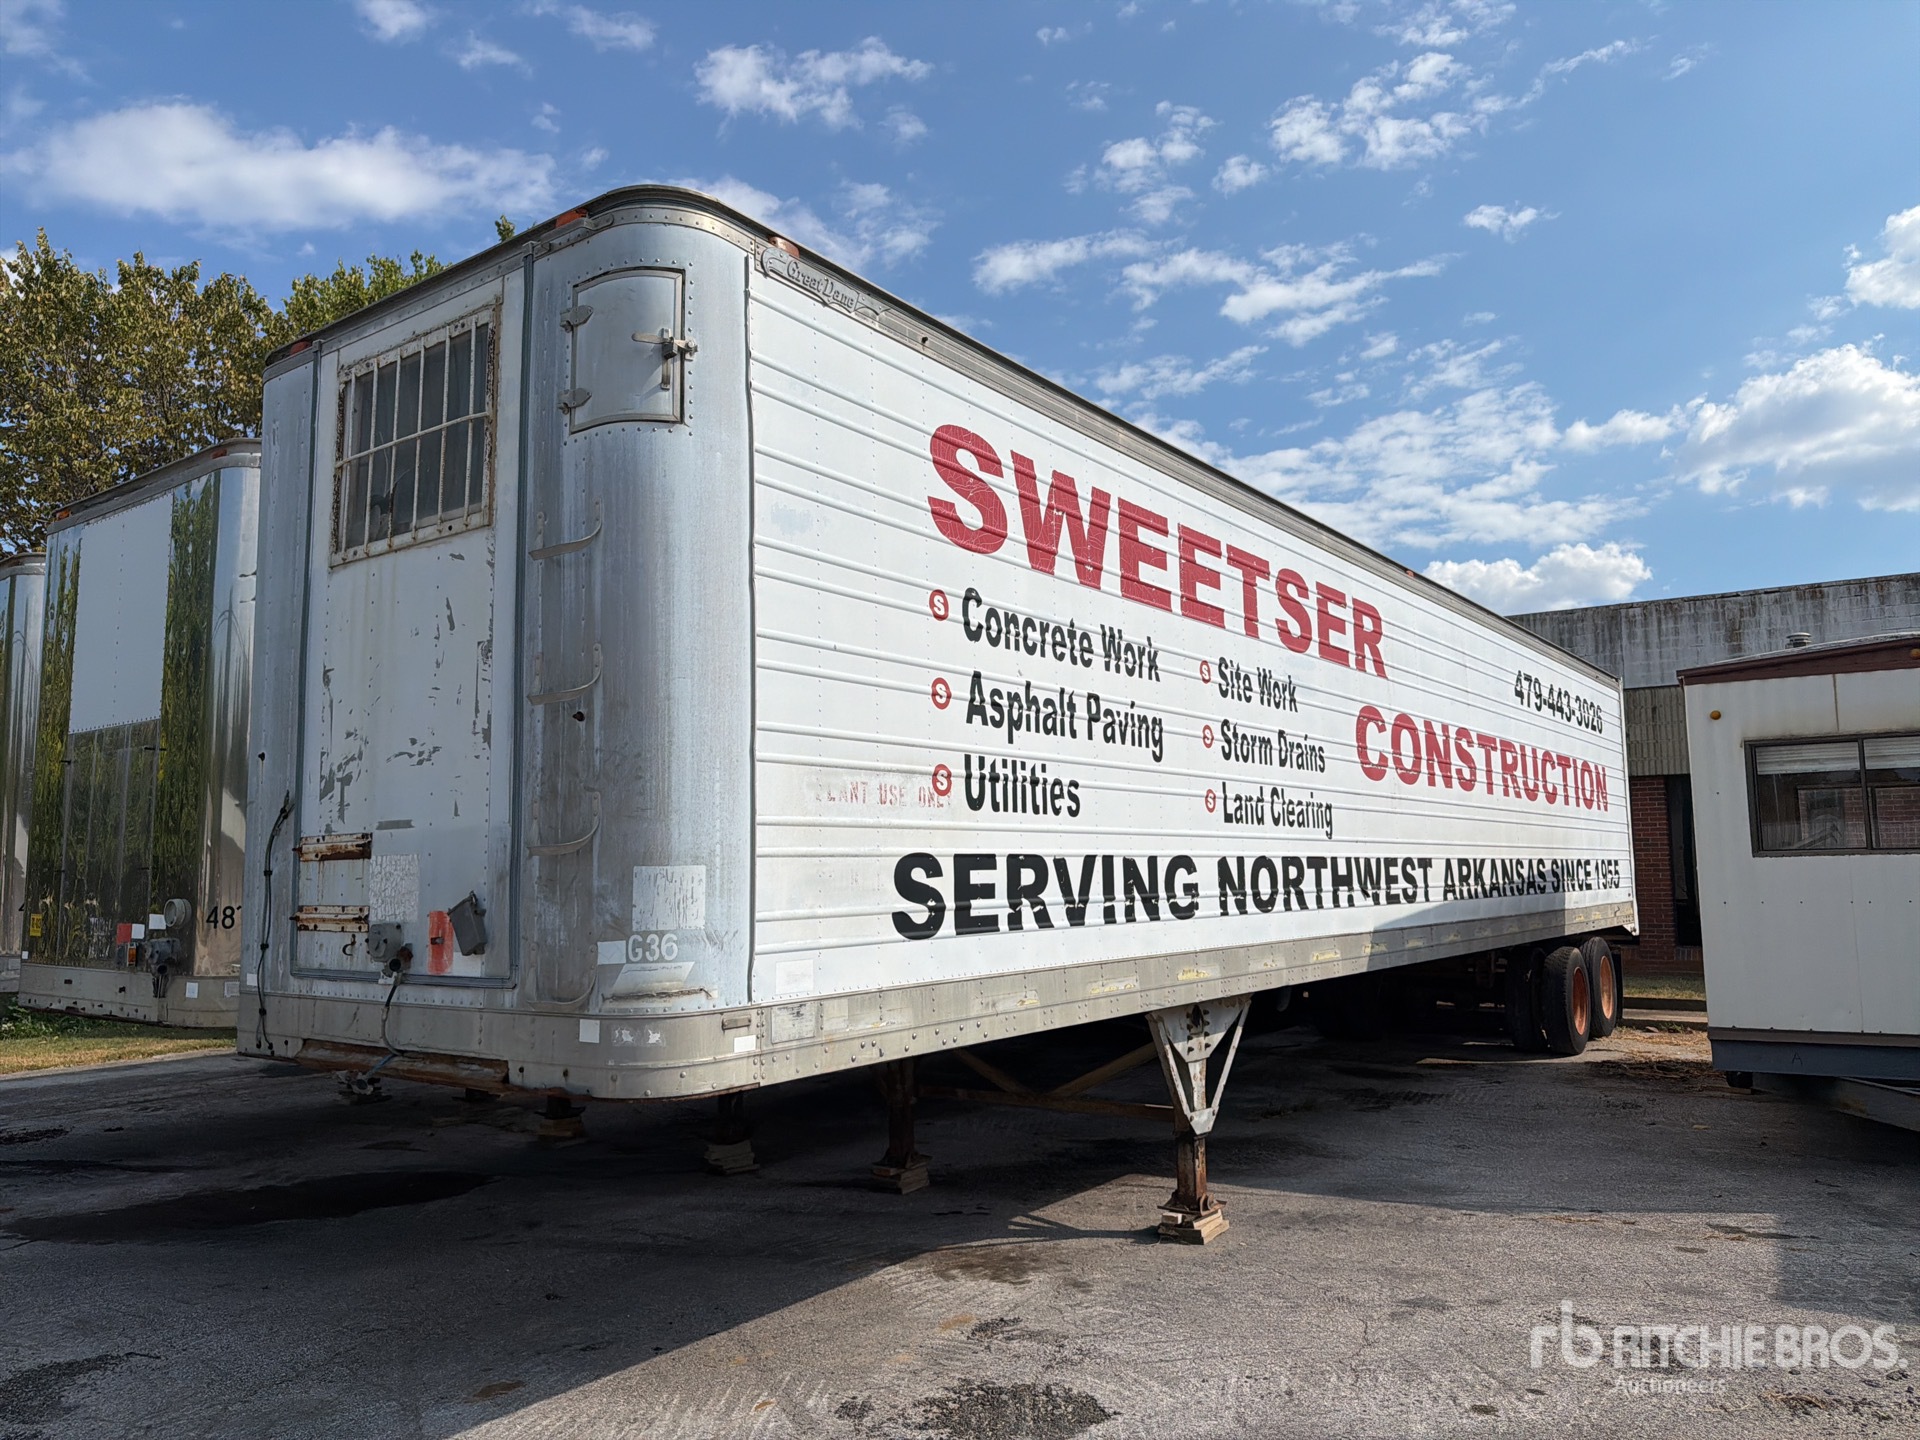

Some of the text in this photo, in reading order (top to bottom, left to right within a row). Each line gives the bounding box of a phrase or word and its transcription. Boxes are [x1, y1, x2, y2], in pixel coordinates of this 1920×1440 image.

[787, 260, 855, 309] Great Dane
[927, 424, 1388, 679] SWEETSER
[961, 587, 1161, 682] Concrete Work
[1218, 656, 1298, 713] Site Work
[1514, 669, 1603, 735] 479-443-3026
[966, 671, 1164, 763] Asphalt Paving
[1220, 718, 1326, 773] Storm Drains
[963, 754, 1080, 818] Utilities
[1356, 705, 1609, 812] CONSTRUCTION
[879, 783, 907, 807] USE
[1222, 781, 1333, 840] Land Clearing
[892, 852, 1199, 940] SERVING
[1217, 854, 1432, 916] NORTHWEST
[1443, 858, 1547, 901] ARKANSAS
[1550, 858, 1593, 893] SINCE
[1595, 859, 1620, 889] 1955
[628, 933, 679, 962] G36
